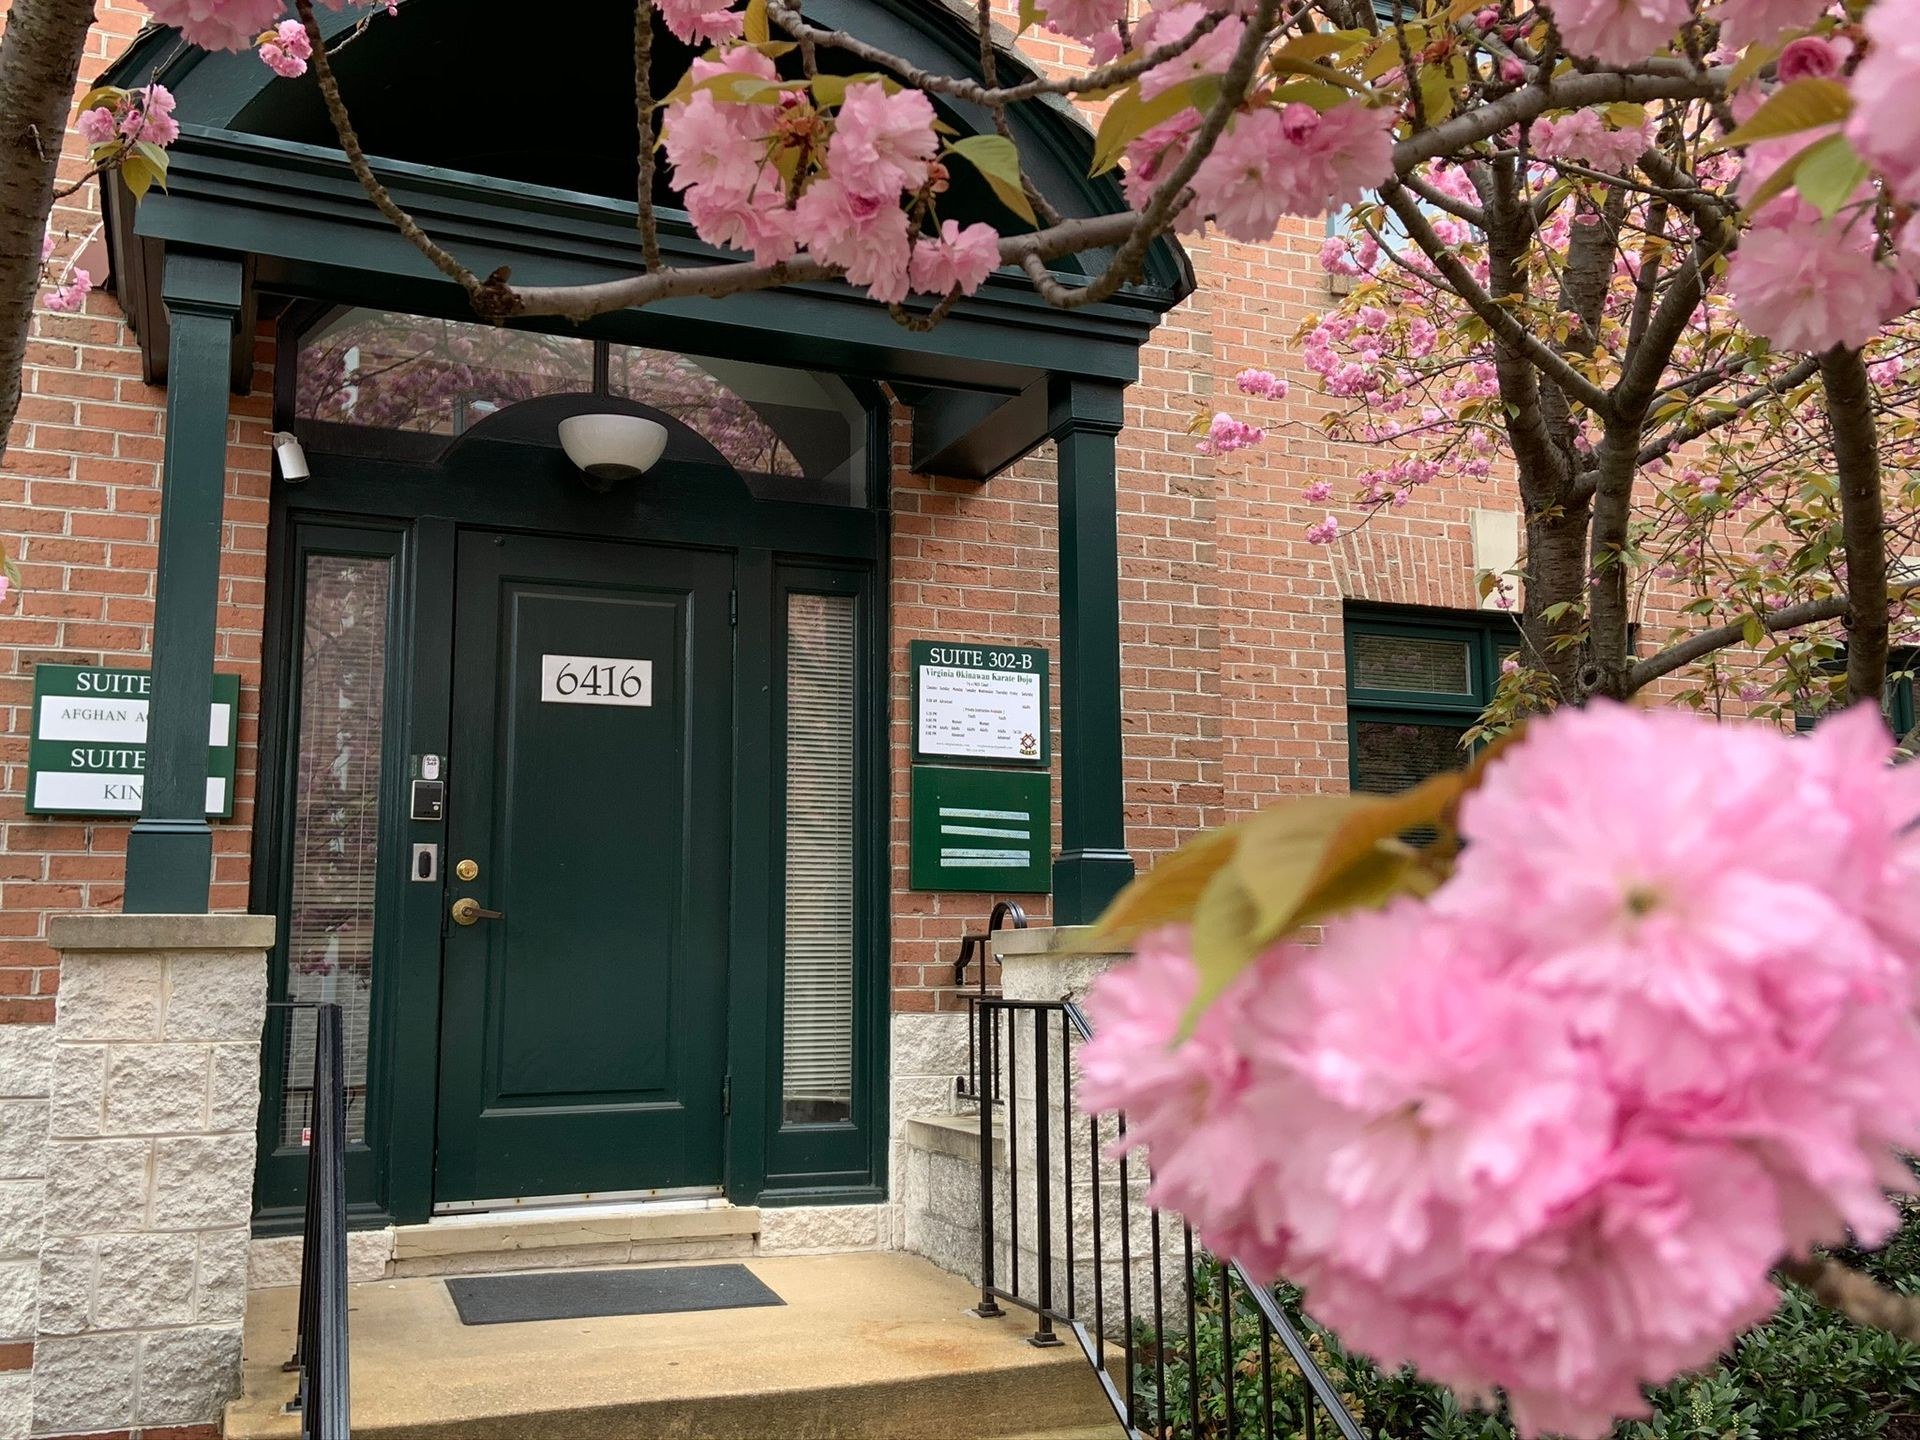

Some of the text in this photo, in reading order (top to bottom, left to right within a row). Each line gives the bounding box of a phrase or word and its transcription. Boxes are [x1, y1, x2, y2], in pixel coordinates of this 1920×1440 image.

[930, 648, 1033, 669] SUITE 302-B
[77, 672, 151, 694] SUITE
[556, 662, 642, 698] 6416
[926, 668, 1033, 685] Virginia Okinawan Karate Dojo
[61, 708, 149, 722] AFGHAN A
[71, 748, 146, 769] SUITE
